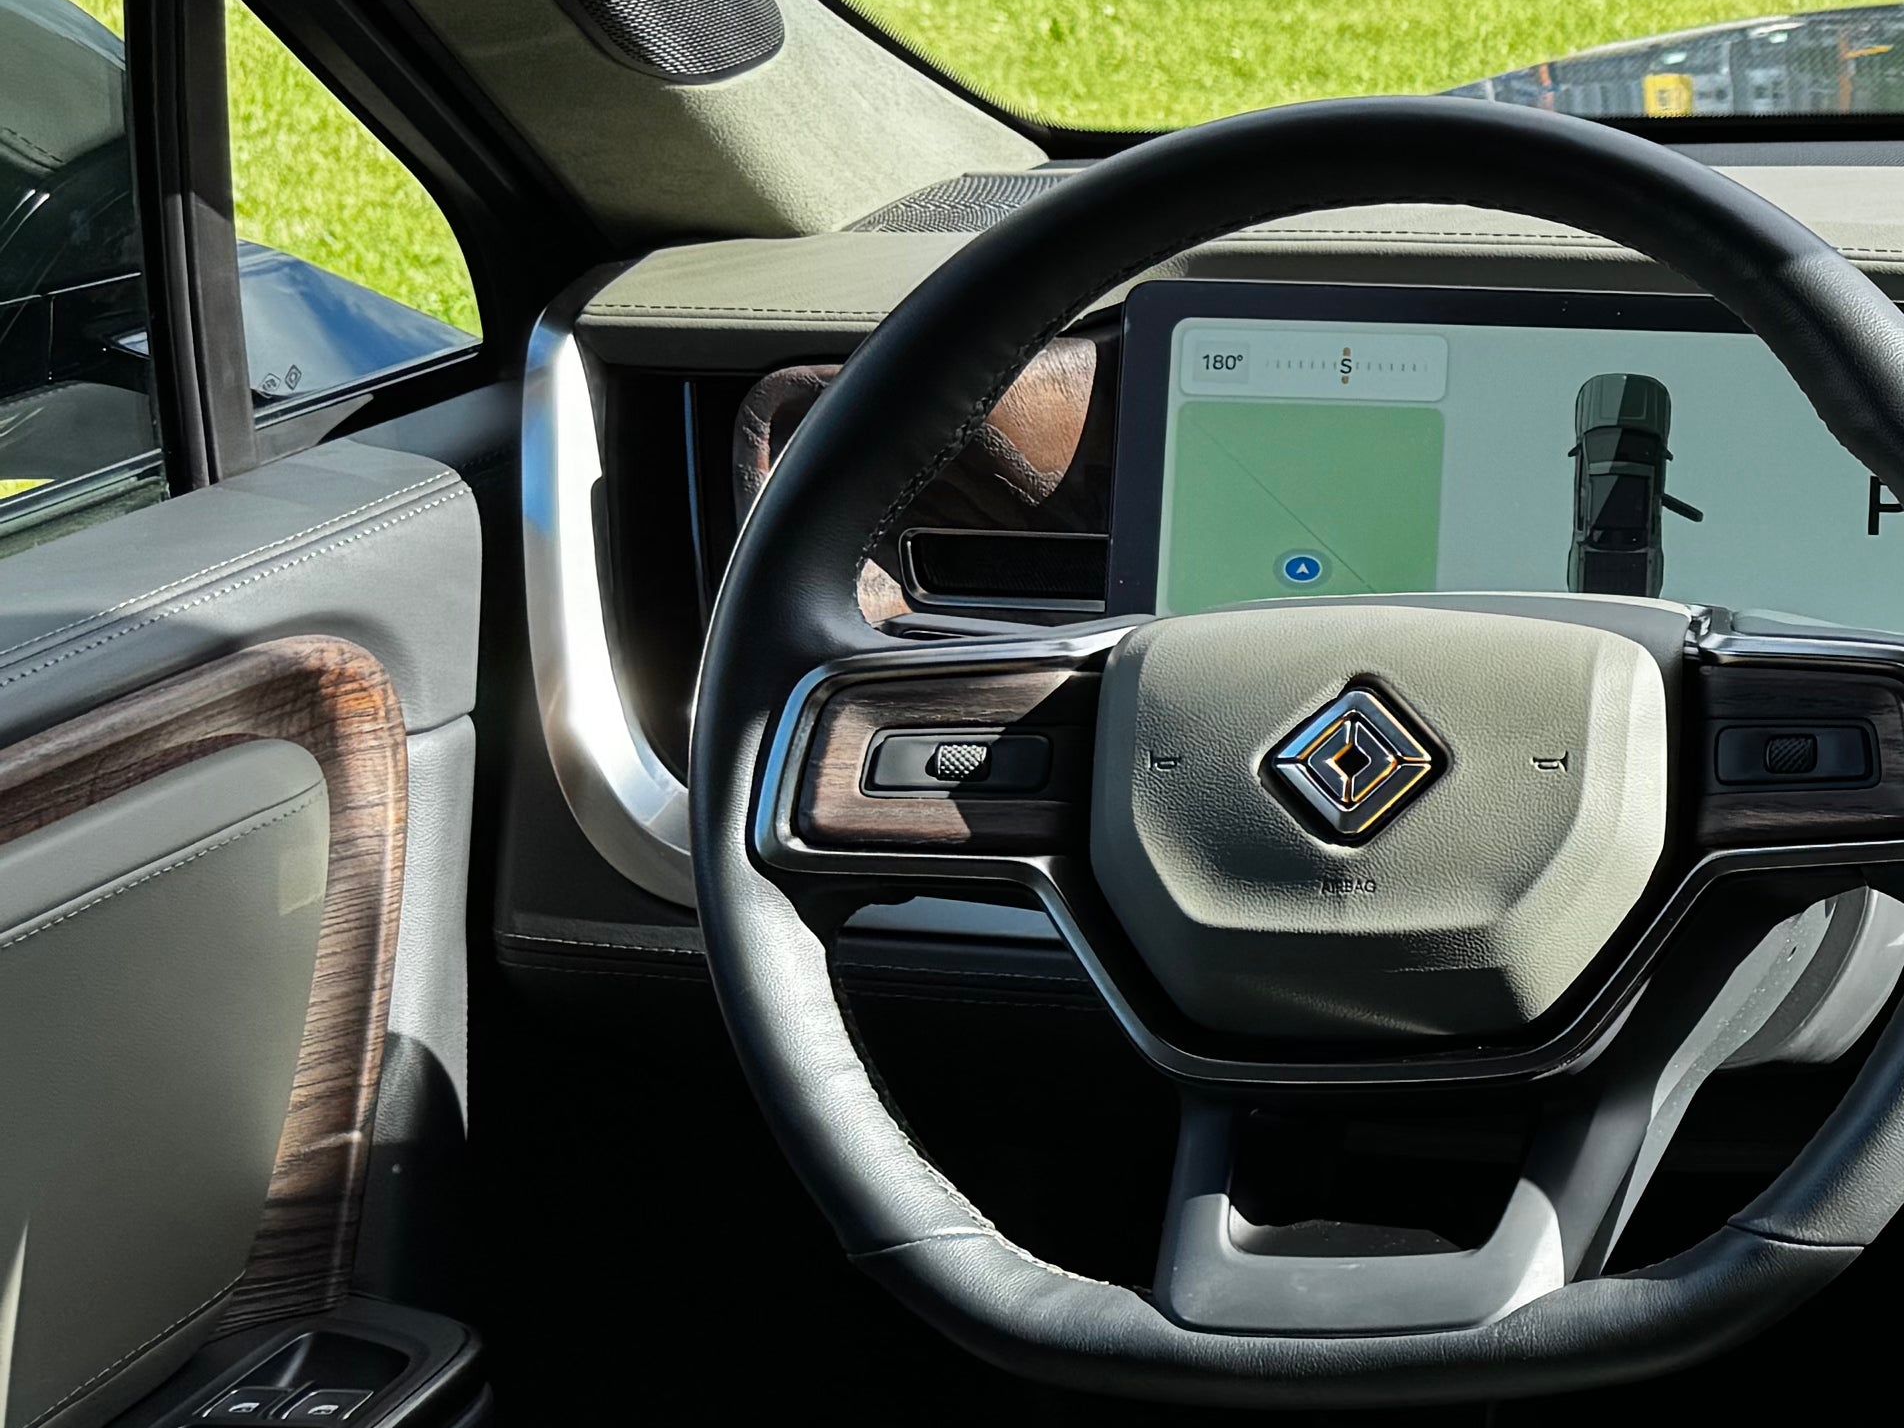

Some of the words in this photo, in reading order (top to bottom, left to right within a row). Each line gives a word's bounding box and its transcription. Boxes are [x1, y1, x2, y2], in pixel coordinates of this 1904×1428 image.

[1202, 354, 1243, 370] 180°
[1340, 358, 1352, 374] S
[1321, 879, 1377, 895] AIRBAG
